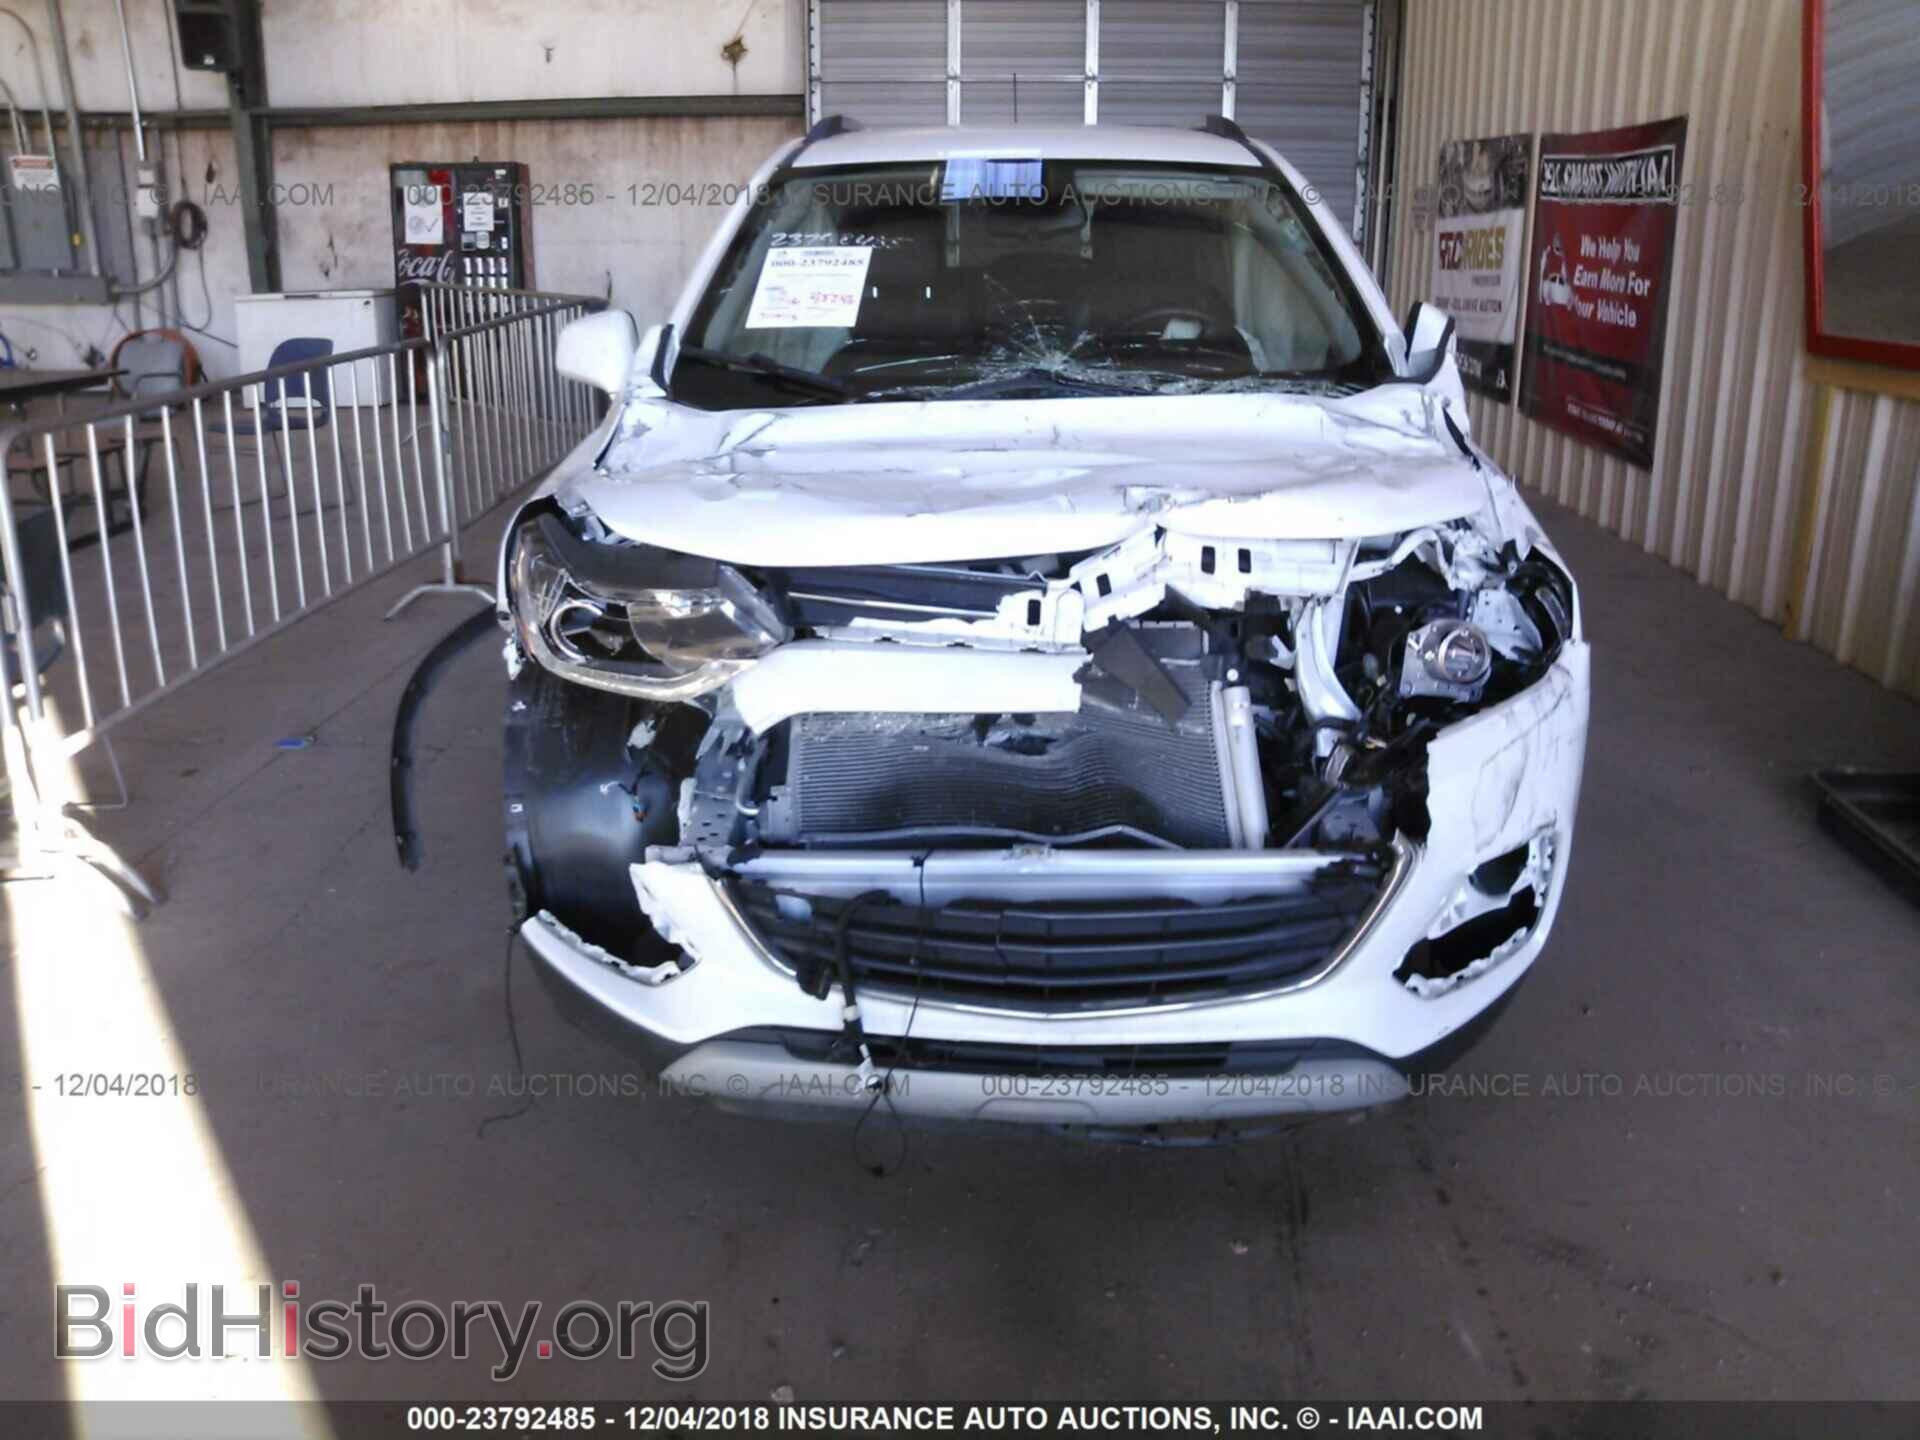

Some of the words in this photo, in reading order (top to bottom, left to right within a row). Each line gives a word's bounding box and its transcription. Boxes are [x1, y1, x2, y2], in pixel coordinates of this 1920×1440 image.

[1598, 235, 1621, 264] Help
[1624, 237, 1641, 263] You
[1573, 263, 1598, 289] Earn
[1627, 271, 1651, 297] For
[1597, 298, 1638, 328] Vehicle
